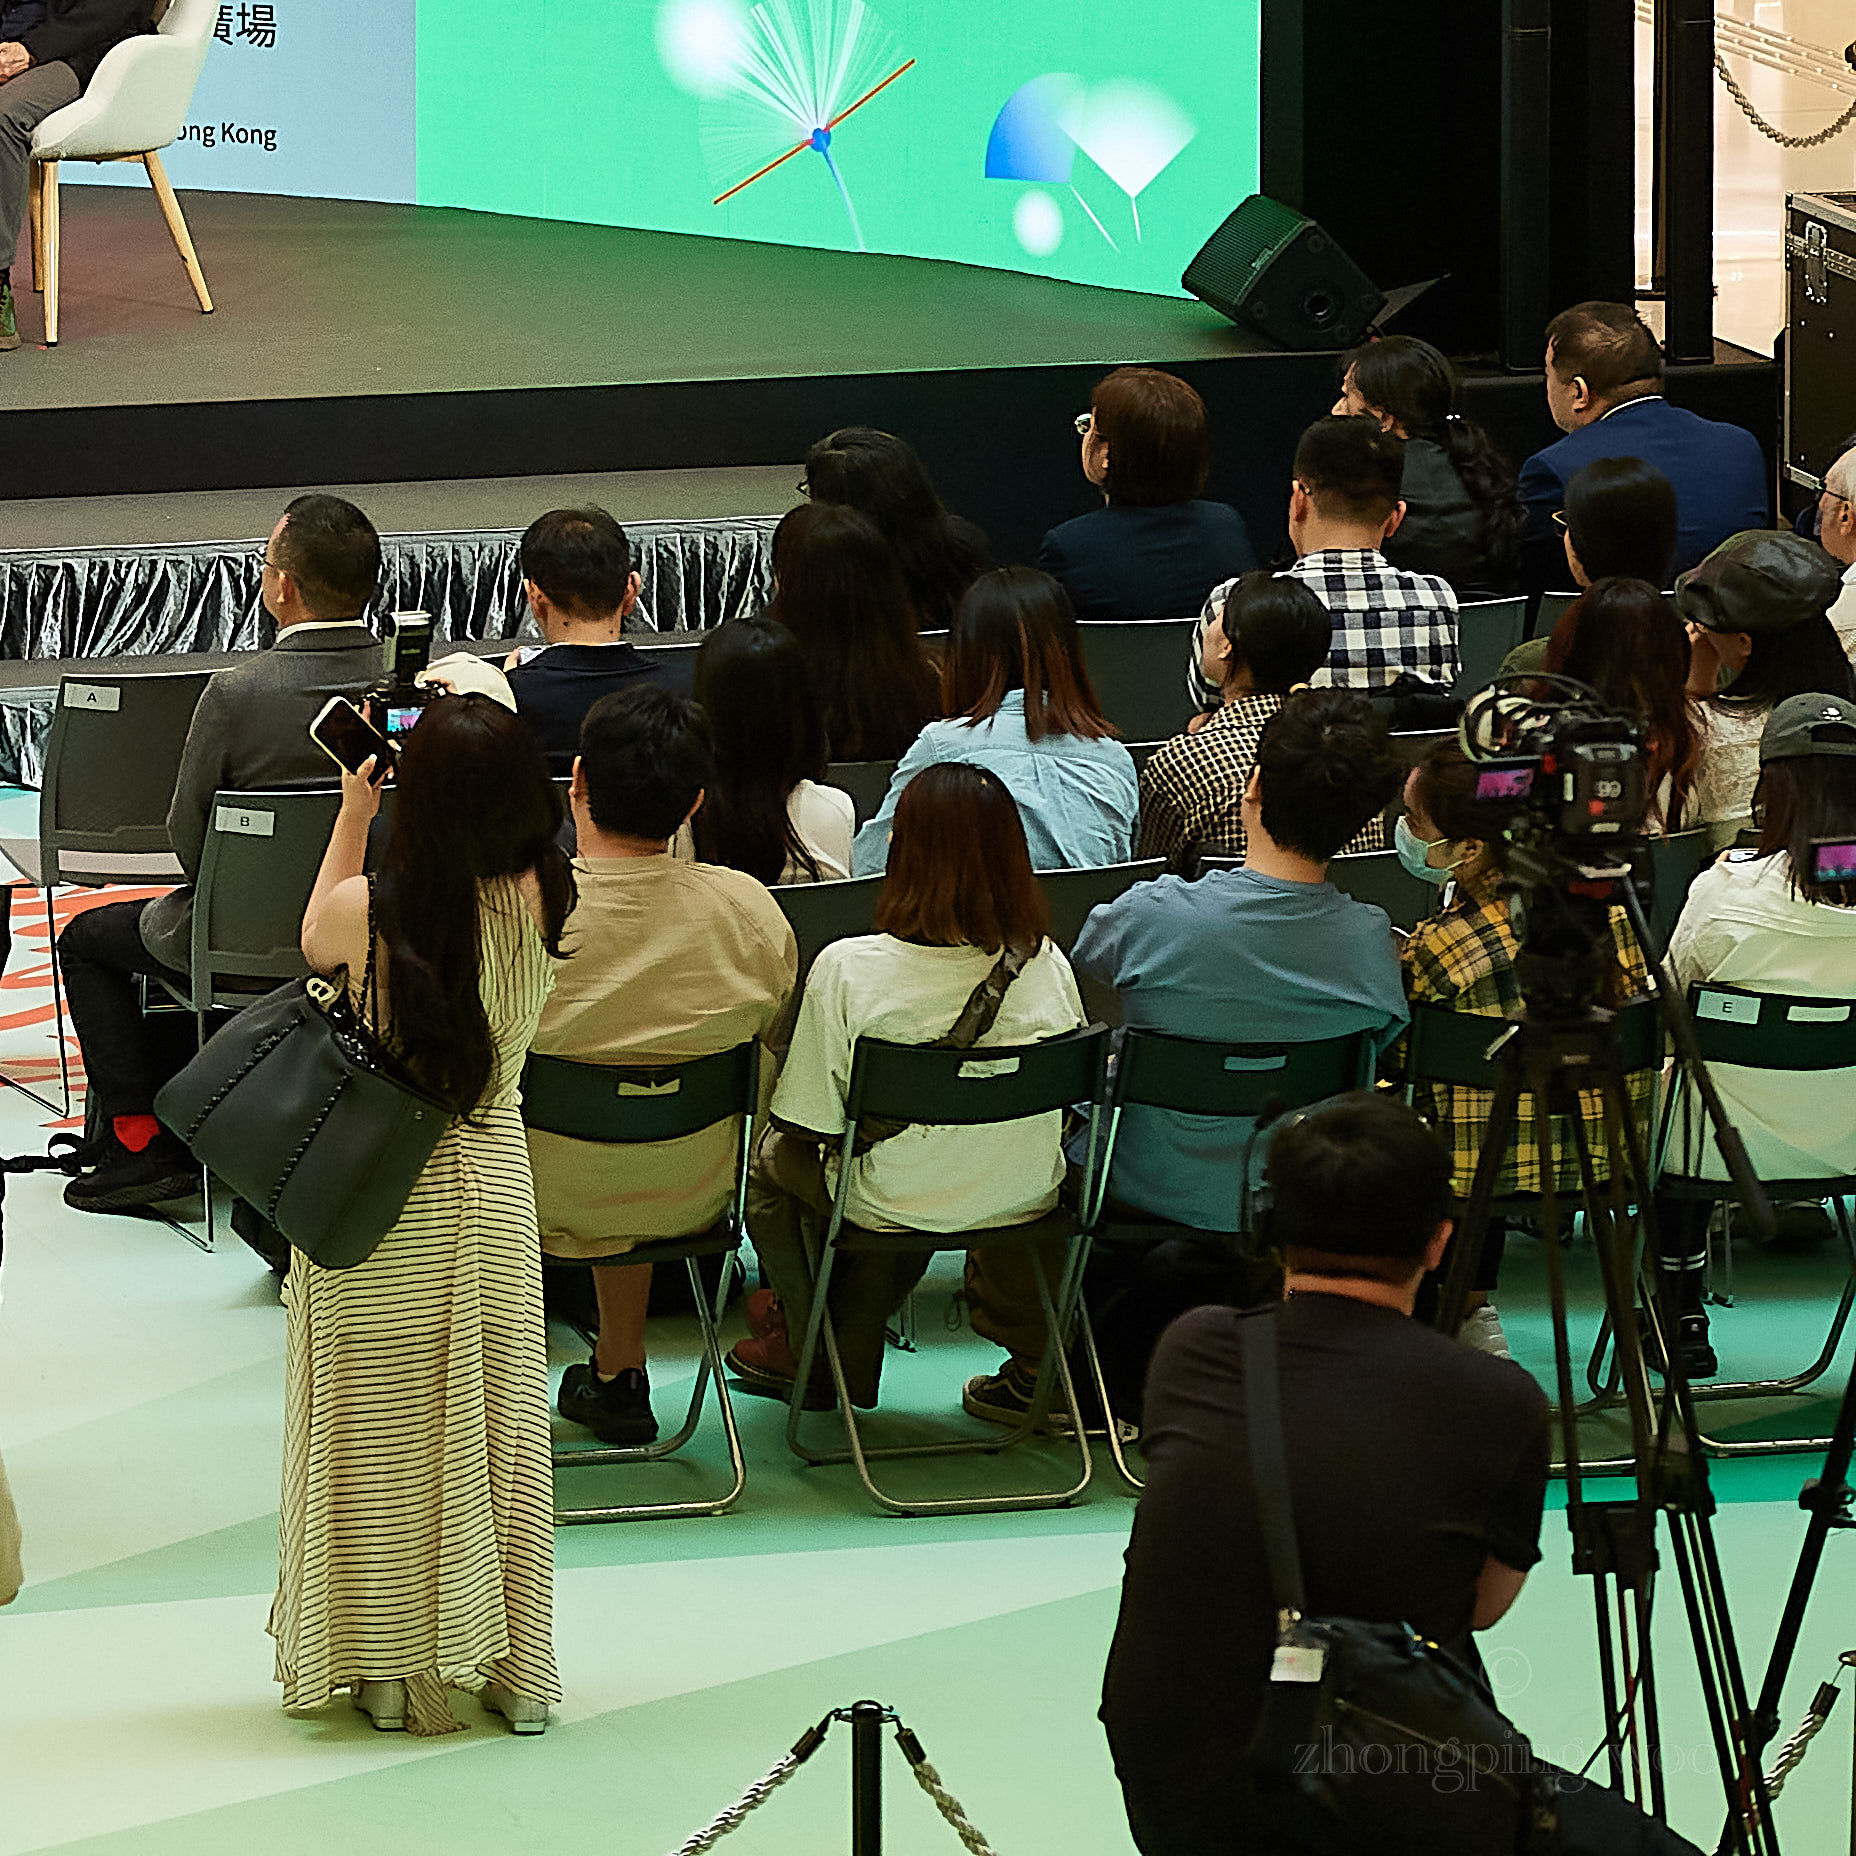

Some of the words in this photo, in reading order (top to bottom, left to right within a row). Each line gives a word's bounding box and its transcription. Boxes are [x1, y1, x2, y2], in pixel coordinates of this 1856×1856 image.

[221, 121, 278, 152] Kong
[86, 692, 97, 703] A
[240, 816, 250, 828] B
[1722, 1002, 1733, 1014] E
